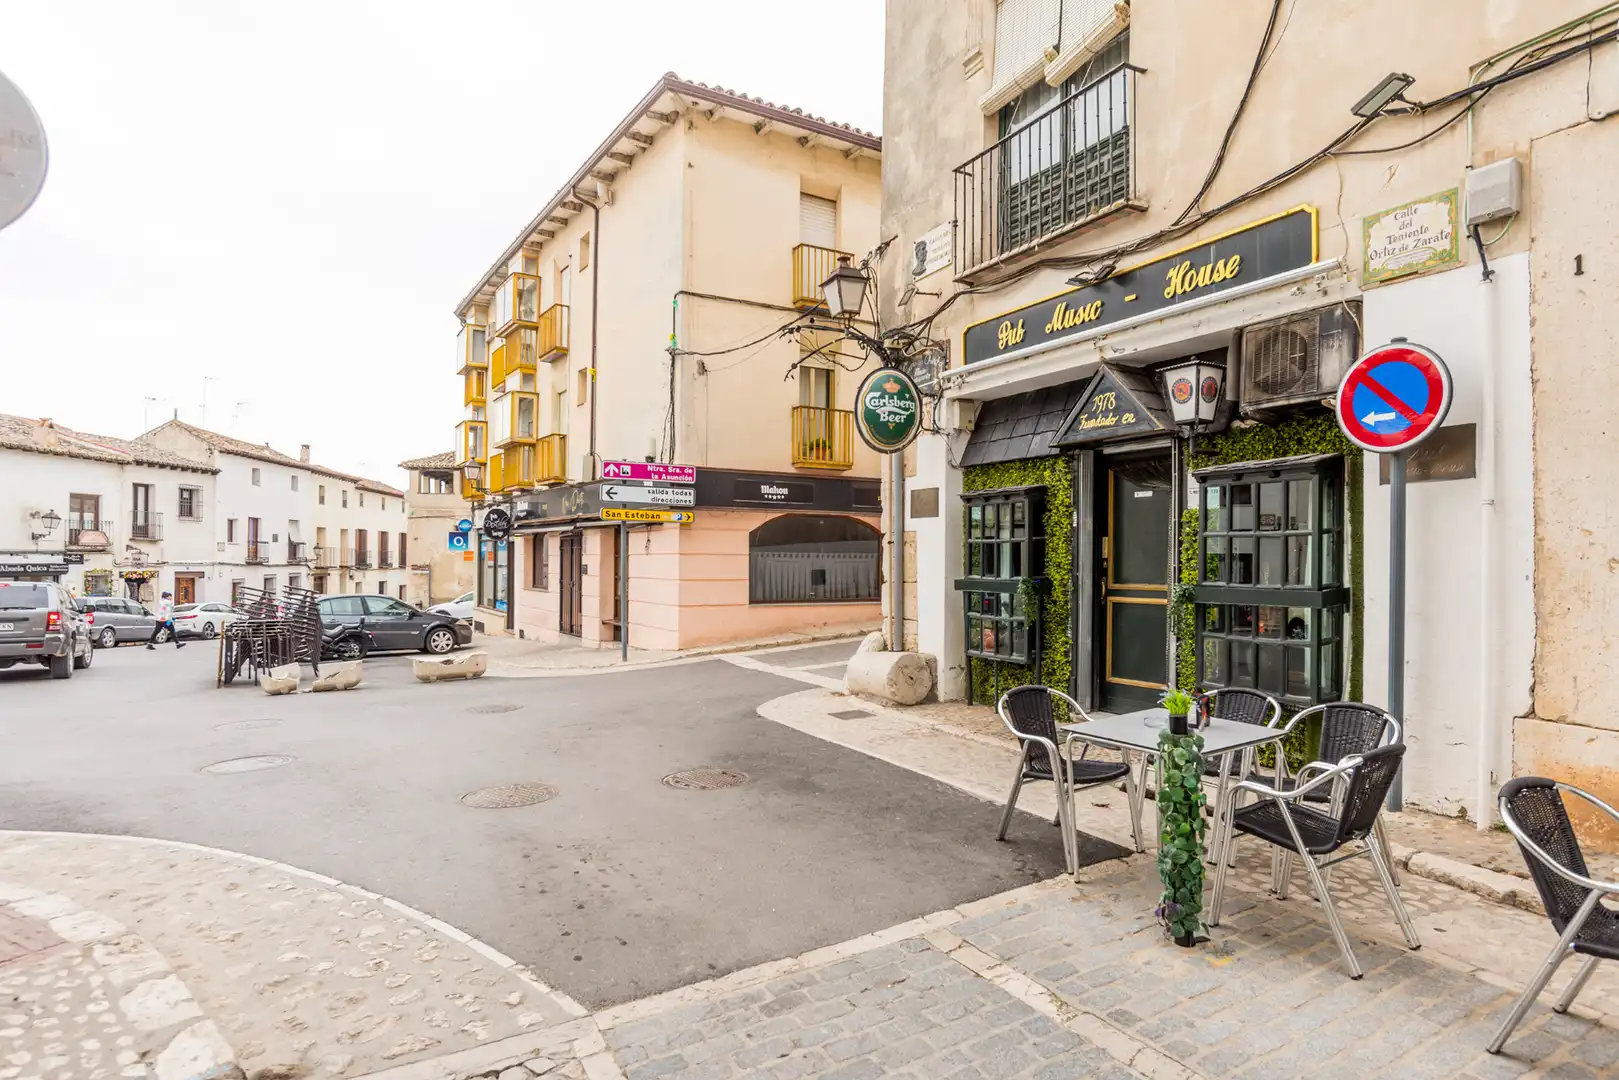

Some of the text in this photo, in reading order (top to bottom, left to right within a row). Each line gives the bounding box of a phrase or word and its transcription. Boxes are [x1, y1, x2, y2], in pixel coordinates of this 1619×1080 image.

[1393, 206, 1419, 221] Calle
[1398, 217, 1413, 231] del
[1386, 225, 1429, 245] Teniente
[1369, 229, 1451, 261] Ortiz de Zarate
[998, 318, 1025, 350] Pub
[1045, 299, 1103, 334] Music
[1164, 254, 1241, 299] House
[865, 391, 916, 413] Carlsberg
[1092, 391, 1116, 414] 1978
[880, 411, 907, 423] Beer
[1121, 413, 1136, 424] en
[647, 465, 693, 474] Ntra. Sra. de
[661, 473, 693, 482] Asunción
[672, 489, 692, 497] todas
[651, 496, 692, 504] direcciones
[605, 510, 661, 520] San Esteban
[0, 564, 25, 572] Abuela
